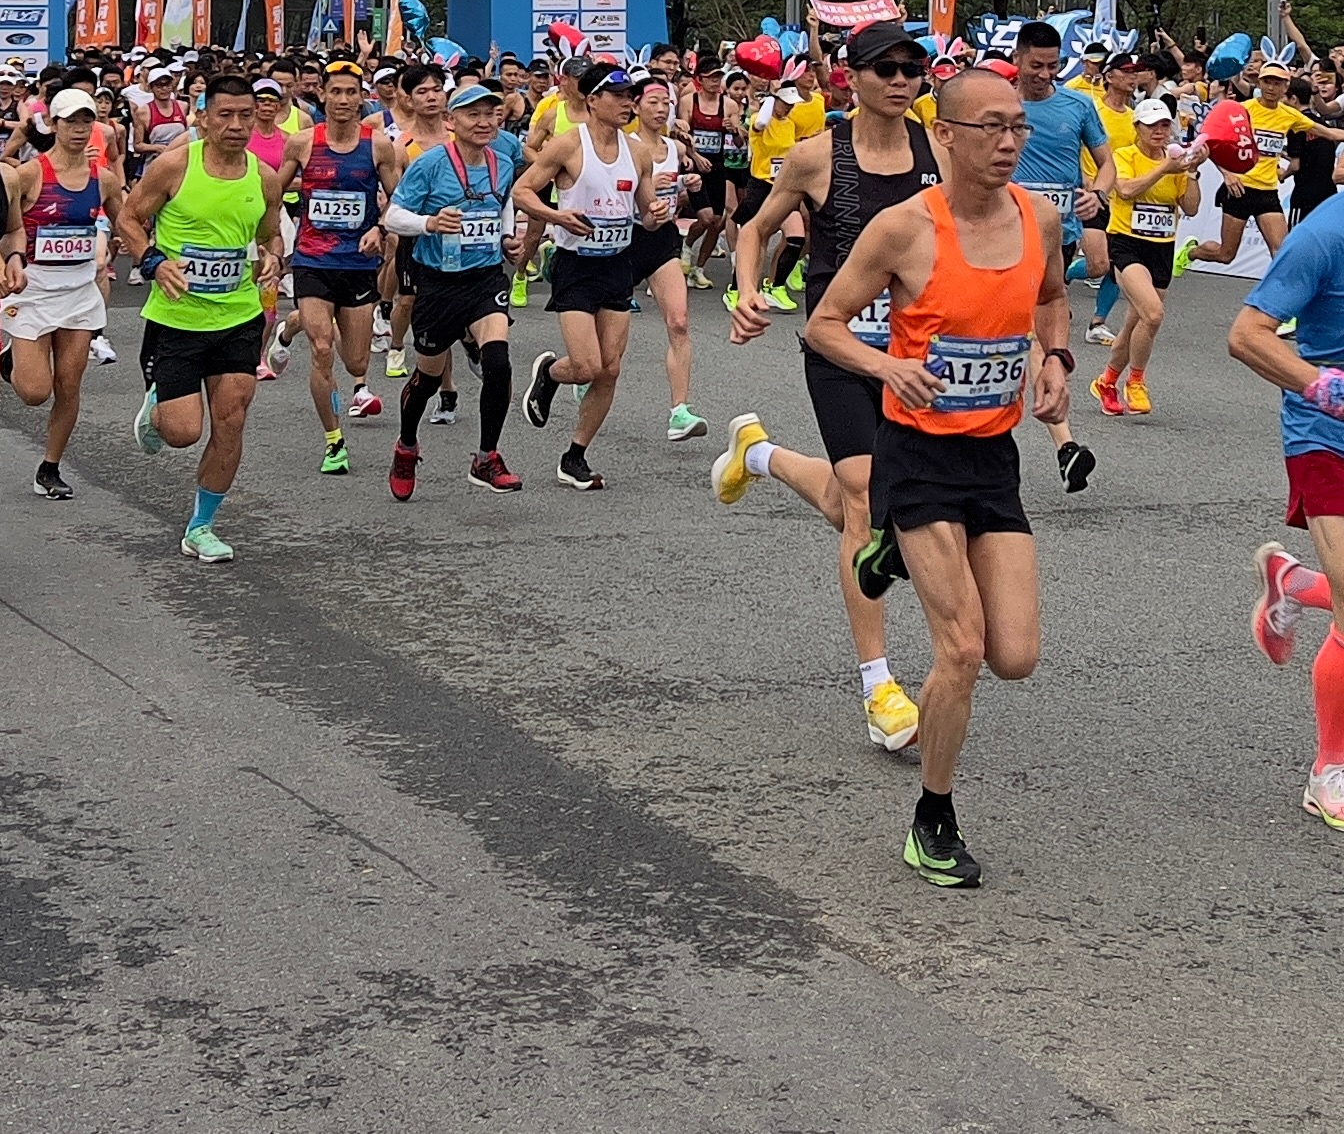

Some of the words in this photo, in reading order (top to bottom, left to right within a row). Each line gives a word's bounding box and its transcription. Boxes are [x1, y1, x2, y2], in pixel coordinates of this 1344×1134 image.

[752, 40, 780, 60] 2:30
[1229, 113, 1254, 161] 1:45
[312, 201, 361, 216] A1255
[1137, 212, 1173, 227] P1006
[585, 228, 629, 244] A1271
[41, 239, 92, 254] A6043
[183, 259, 241, 278] A1601
[940, 357, 1024, 386] A1236
